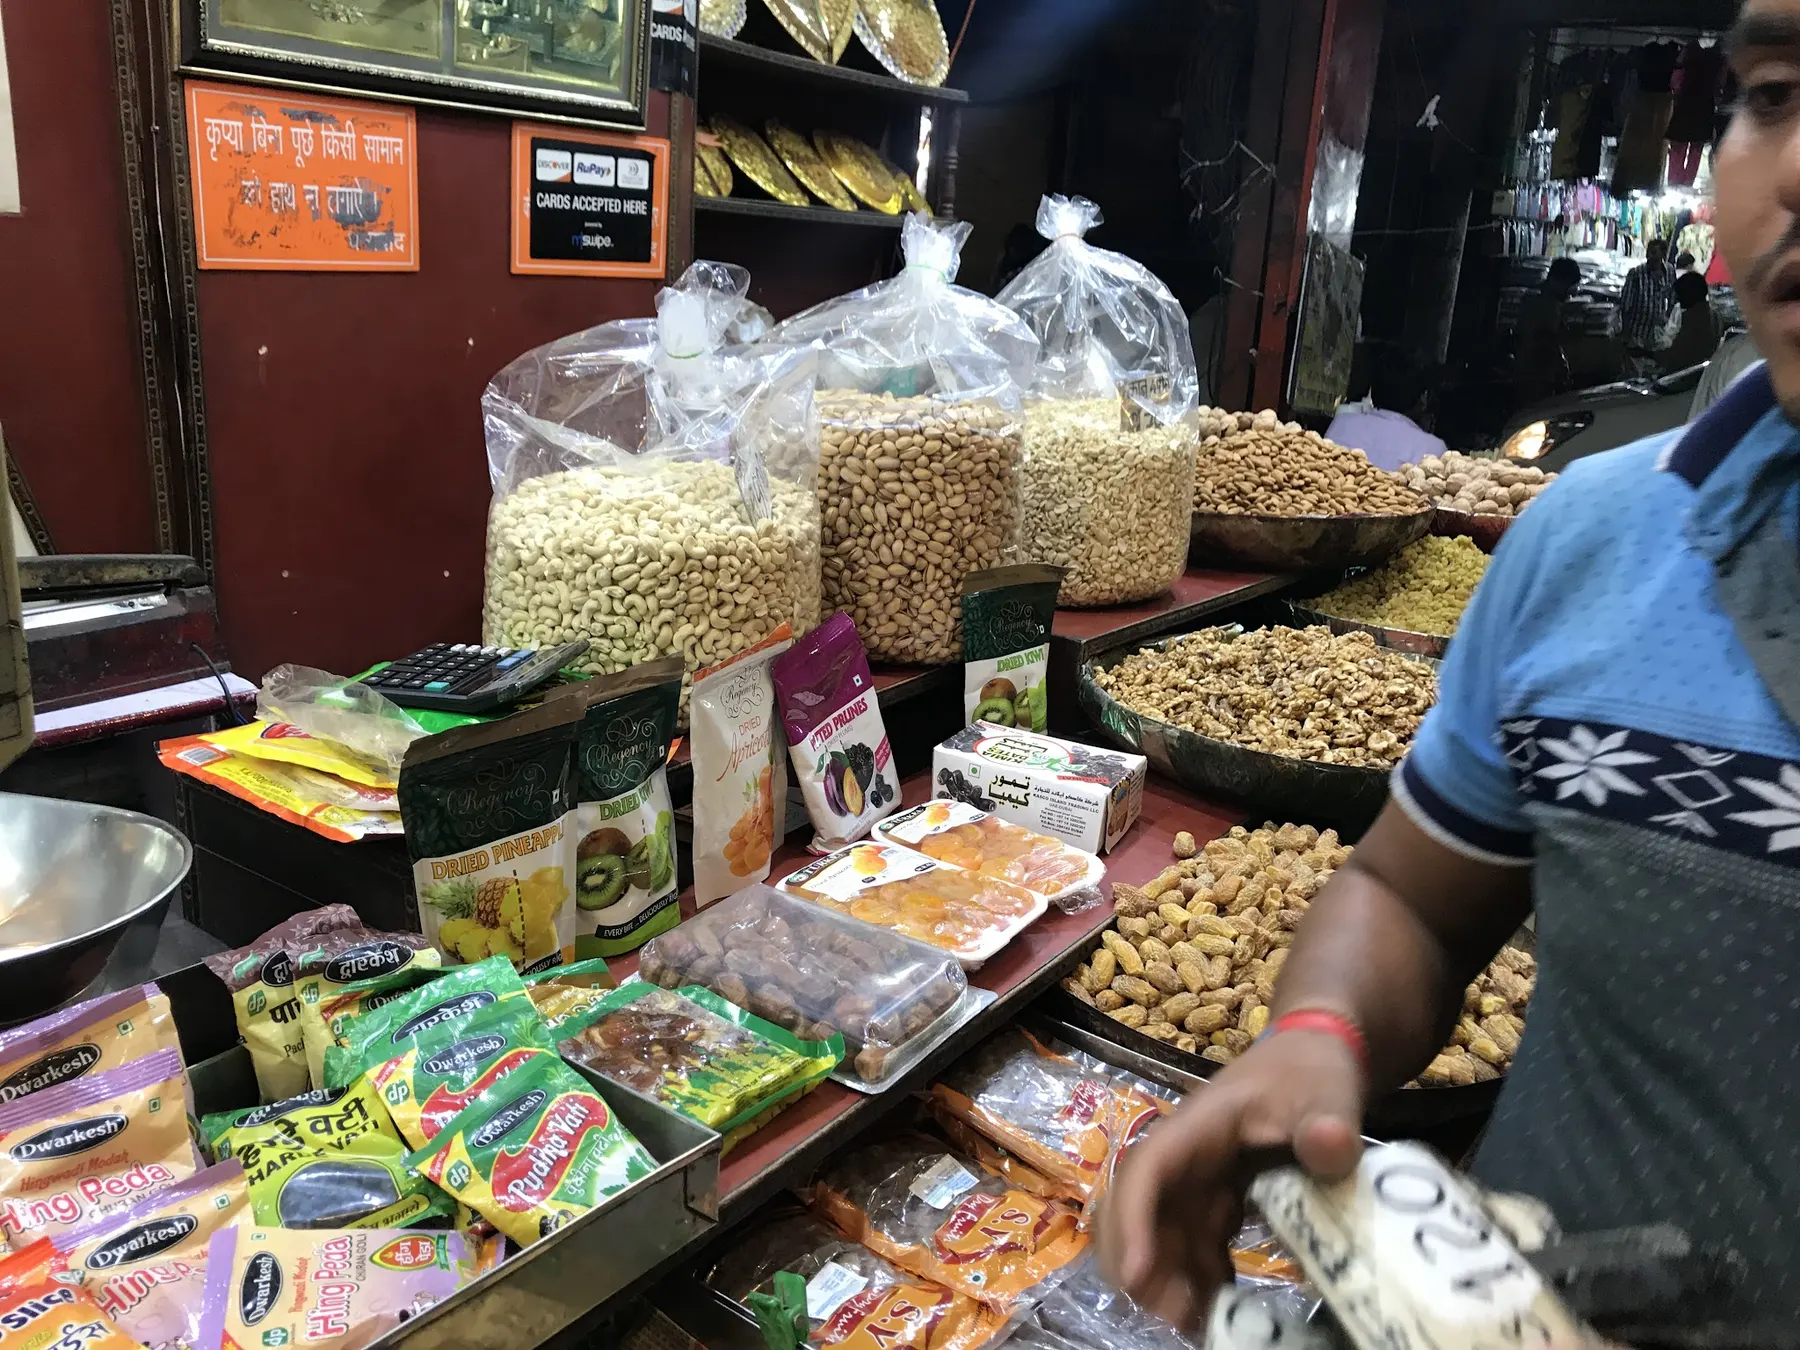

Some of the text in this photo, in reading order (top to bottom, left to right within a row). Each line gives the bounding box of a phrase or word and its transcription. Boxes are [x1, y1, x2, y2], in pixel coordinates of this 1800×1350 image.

[650, 22, 683, 42] CARDS
[321, 120, 356, 161] किसी
[363, 134, 404, 165] सामान
[576, 162, 607, 178] RuPay
[537, 192, 648, 216] CARDS ACCEPTED HERE
[996, 647, 1045, 673] DRIED KIWI
[738, 715, 761, 736] DRIED
[809, 697, 869, 752] PITED PRUNES
[595, 739, 656, 768] Regency
[990, 773, 1031, 791] تمور
[599, 793, 640, 821] DRIED
[431, 823, 565, 880] DRIED PINEAPPL
[604, 926, 623, 938] EVERY
[623, 920, 634, 934] BITE
[638, 897, 670, 923] DELICIOUSLY
[428, 1037, 502, 1073] Dwarkesh
[0, 1049, 94, 1103] Dwarkesh
[387, 1082, 409, 1102] dp
[306, 1097, 371, 1137] वटी
[477, 1093, 543, 1146] Dwarkesh
[19, 1119, 119, 1158] Dwarkesh
[507, 1136, 570, 1201] Pudina
[554, 1098, 590, 1136] Vati
[77, 1161, 174, 1205] Peda
[449, 1165, 471, 1189] dp
[93, 1219, 190, 1267] Dwarkesh
[356, 1232, 368, 1254] GOLI
[98, 1263, 175, 1315] Hing
[248, 1255, 275, 1322] Dwarkesh
[306, 1234, 359, 1339] Hing Peda
[269, 1326, 283, 1347] dp
